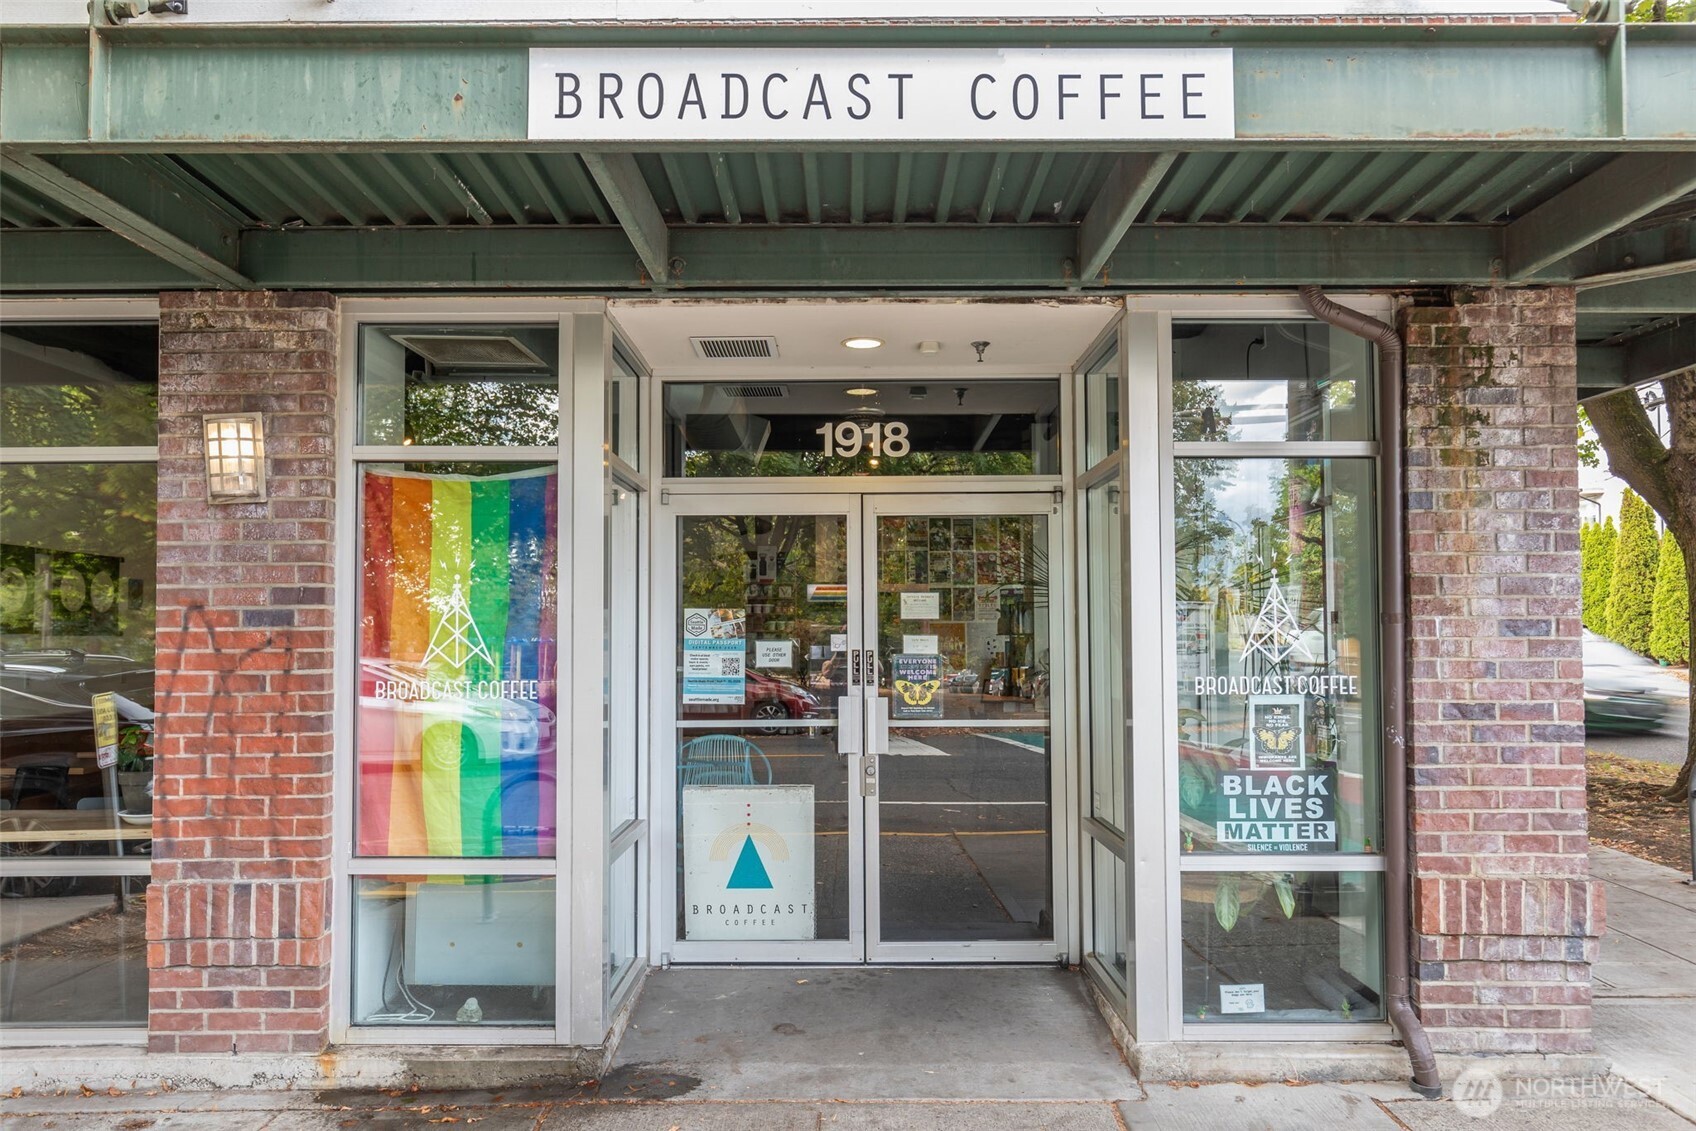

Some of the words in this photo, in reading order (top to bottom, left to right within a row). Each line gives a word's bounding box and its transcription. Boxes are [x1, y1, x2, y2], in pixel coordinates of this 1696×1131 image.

[554, 72, 913, 120] BROADCAST
[970, 72, 1208, 120] COFFEE
[815, 421, 911, 458] 1918
[375, 680, 473, 699] BROADCAST
[478, 680, 538, 699] COFFEE
[1194, 675, 1291, 695] BROADCAST
[1297, 675, 1358, 695] COFFEE
[1223, 775, 1329, 796] BLACK
[1229, 797, 1324, 819] LIVES
[1224, 823, 1330, 840] MATTER
[1247, 843, 1273, 851] SILENCE
[1279, 843, 1308, 851] VIOLENCE
[692, 904, 808, 915] BROADCAST
